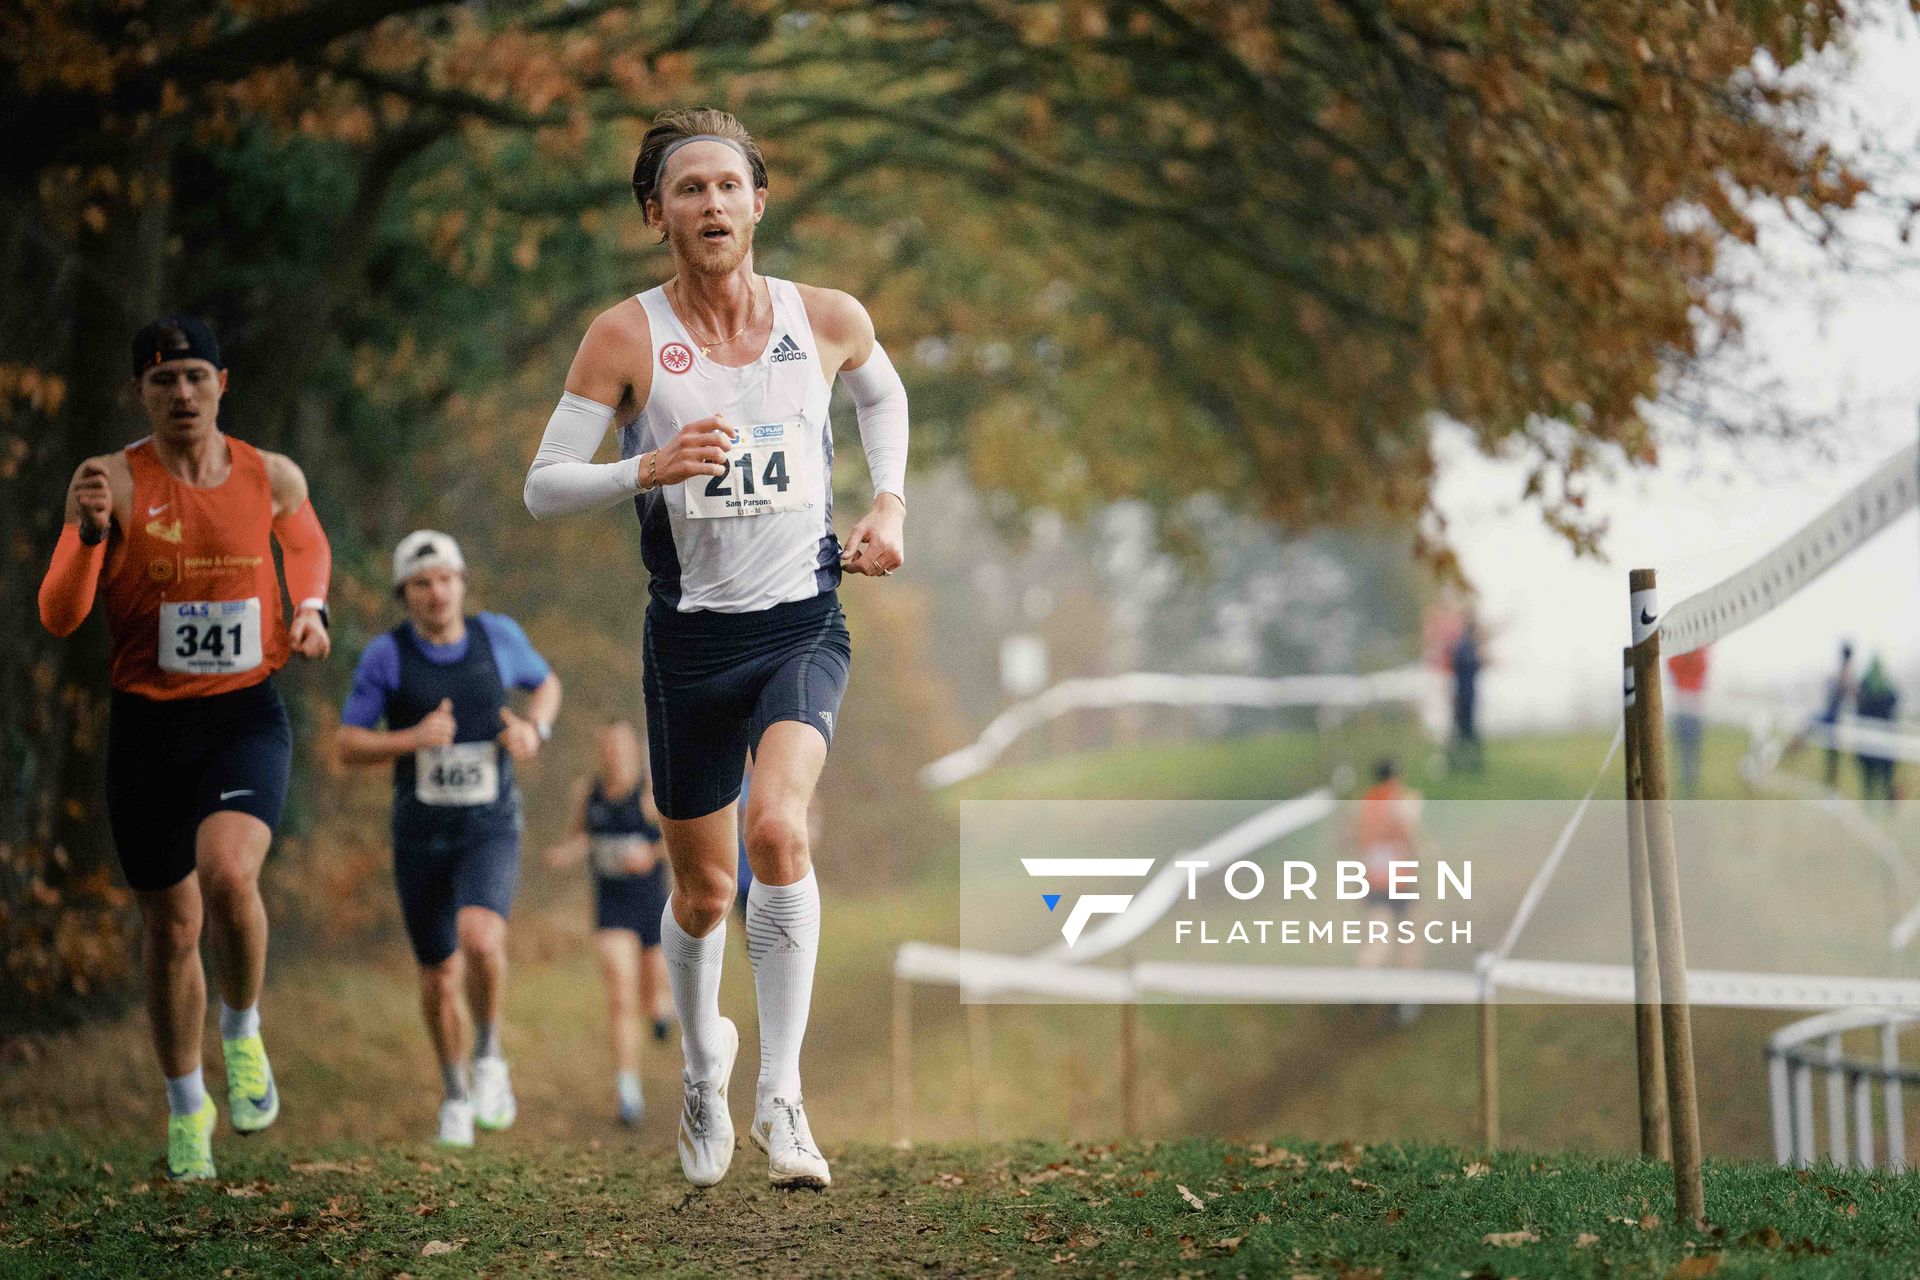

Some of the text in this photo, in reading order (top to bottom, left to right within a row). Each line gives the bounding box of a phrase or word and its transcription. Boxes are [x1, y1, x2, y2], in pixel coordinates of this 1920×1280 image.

[770, 351, 808, 364] adidas
[704, 452, 790, 497] 214
[725, 498, 772, 508] Sam Parsons
[175, 623, 242, 657] 341
